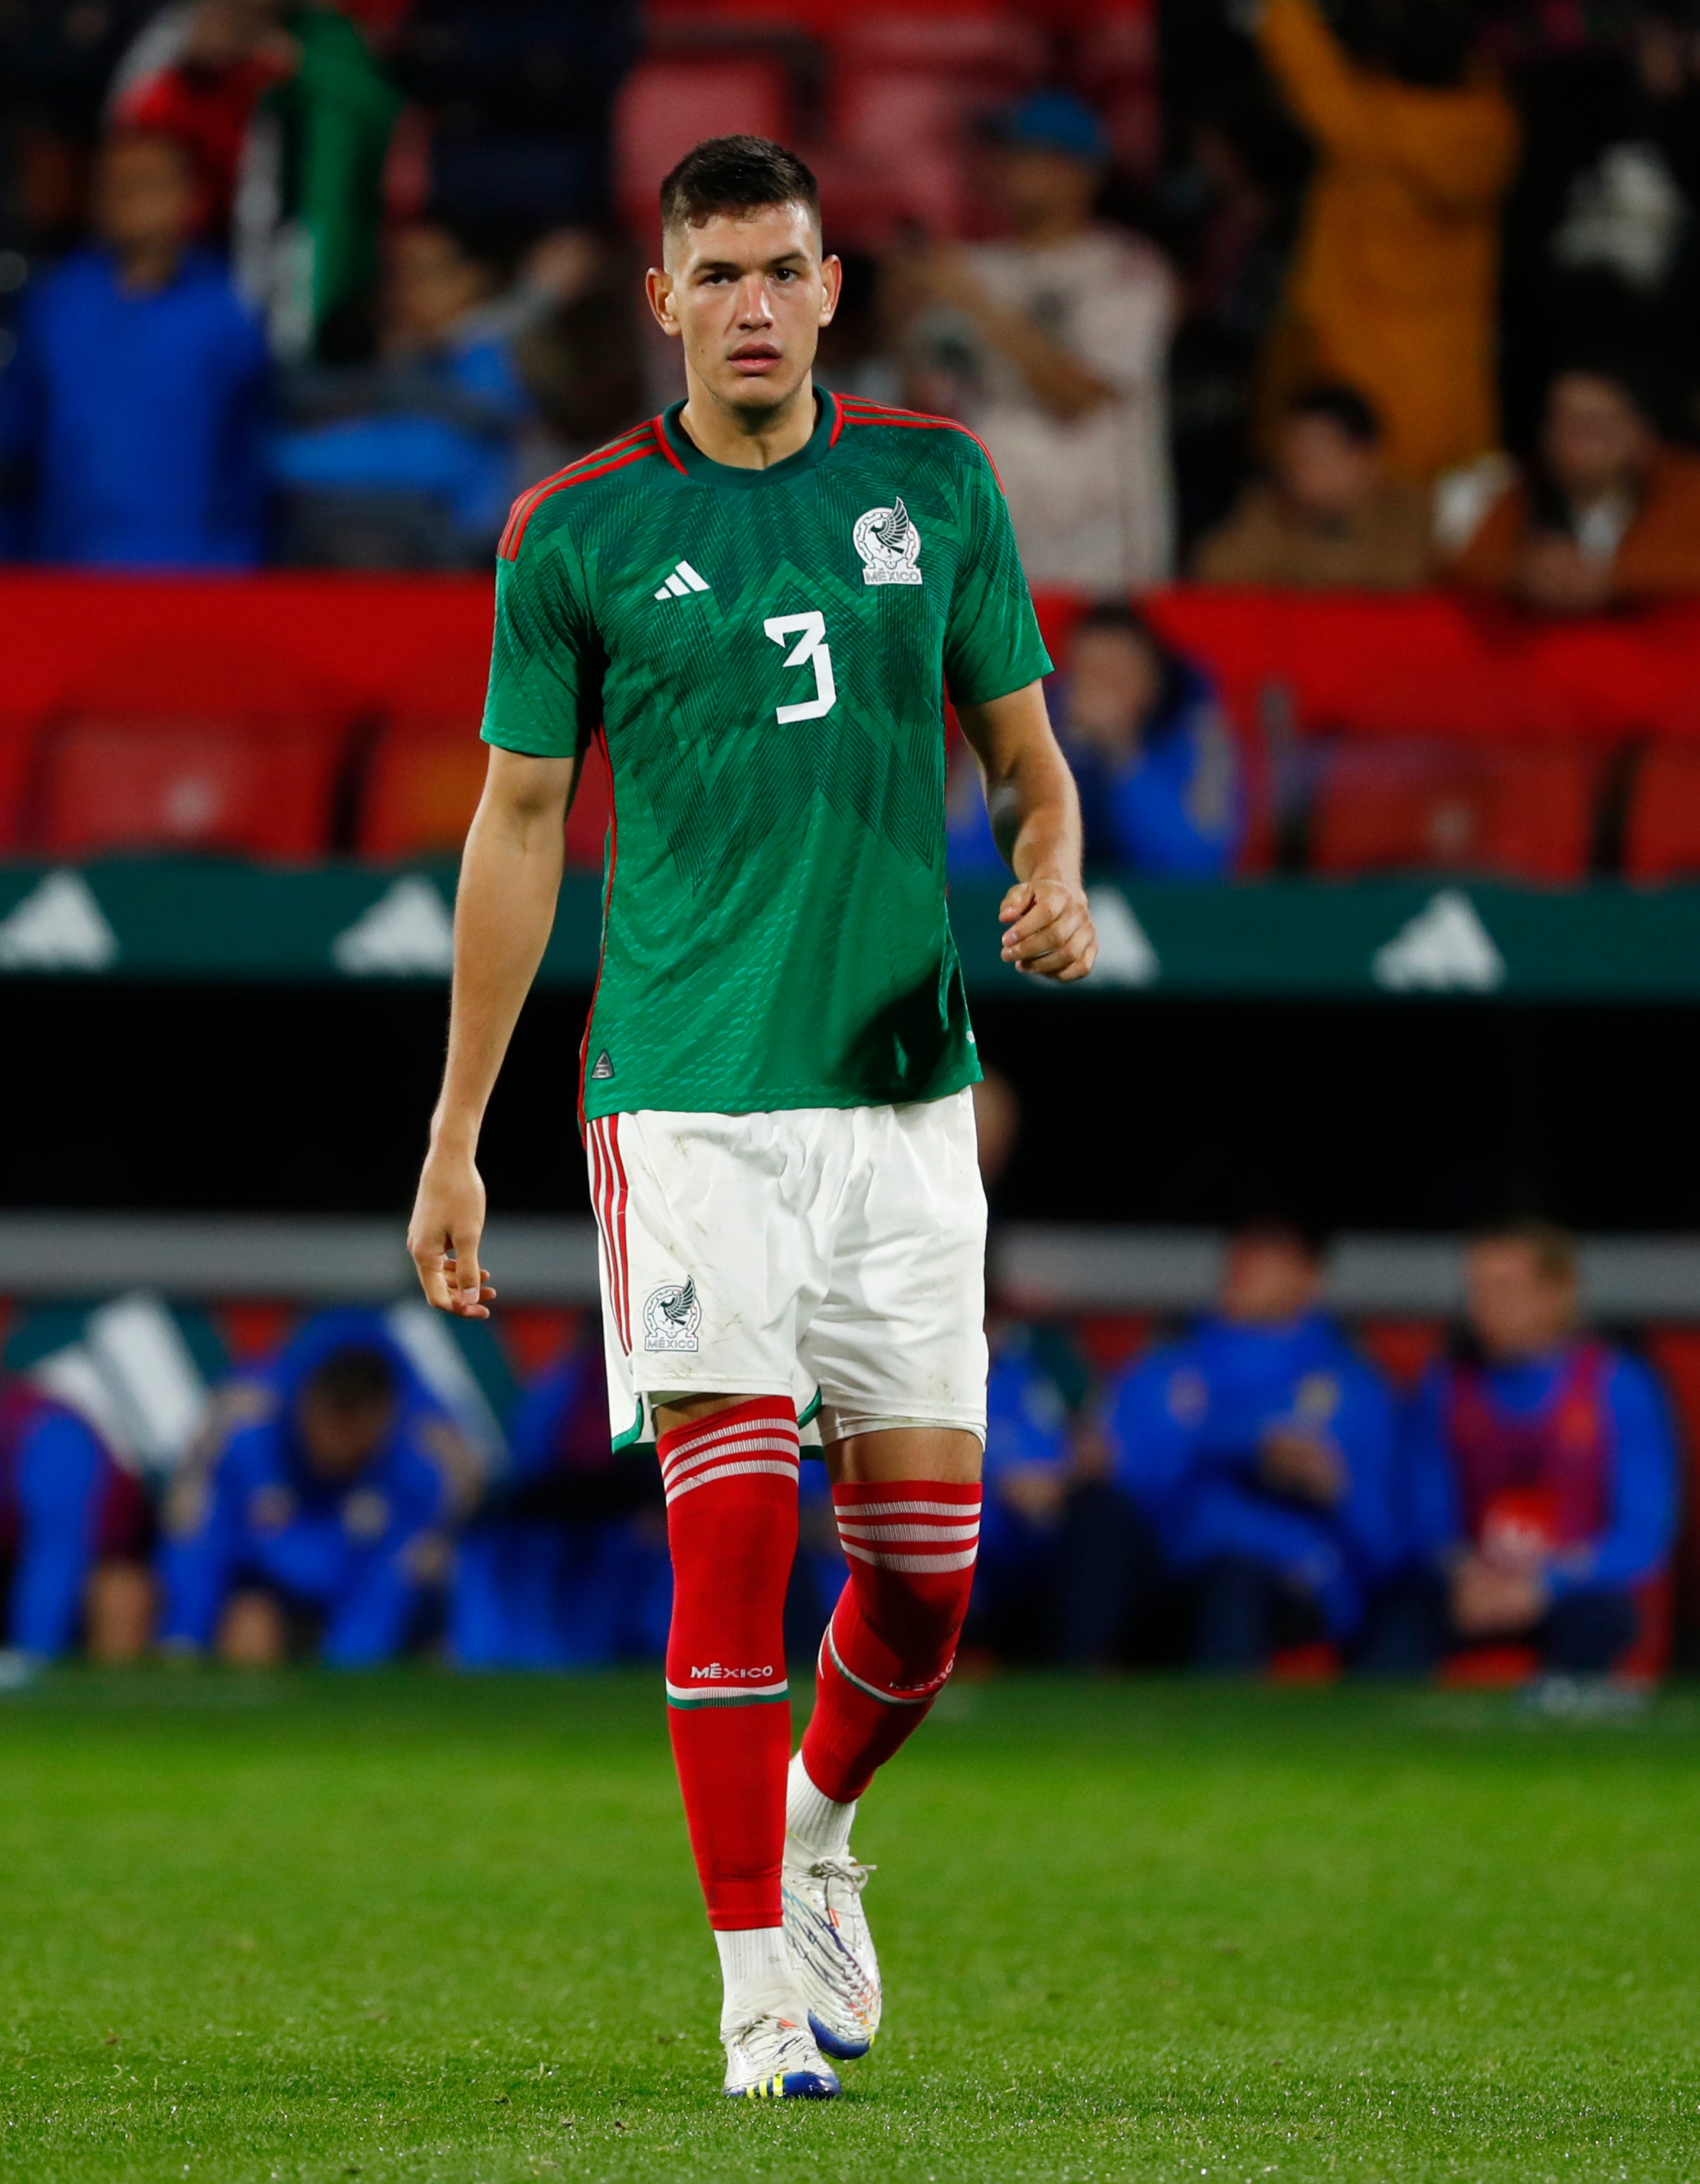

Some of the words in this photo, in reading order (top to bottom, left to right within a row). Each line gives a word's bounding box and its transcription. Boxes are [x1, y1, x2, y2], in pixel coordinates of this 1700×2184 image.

[865, 568, 920, 582] MÉXICO
[763, 610, 837, 725] 3
[647, 1336, 696, 1349] MÉXICO
[690, 1662, 774, 1679] MÉXICO
